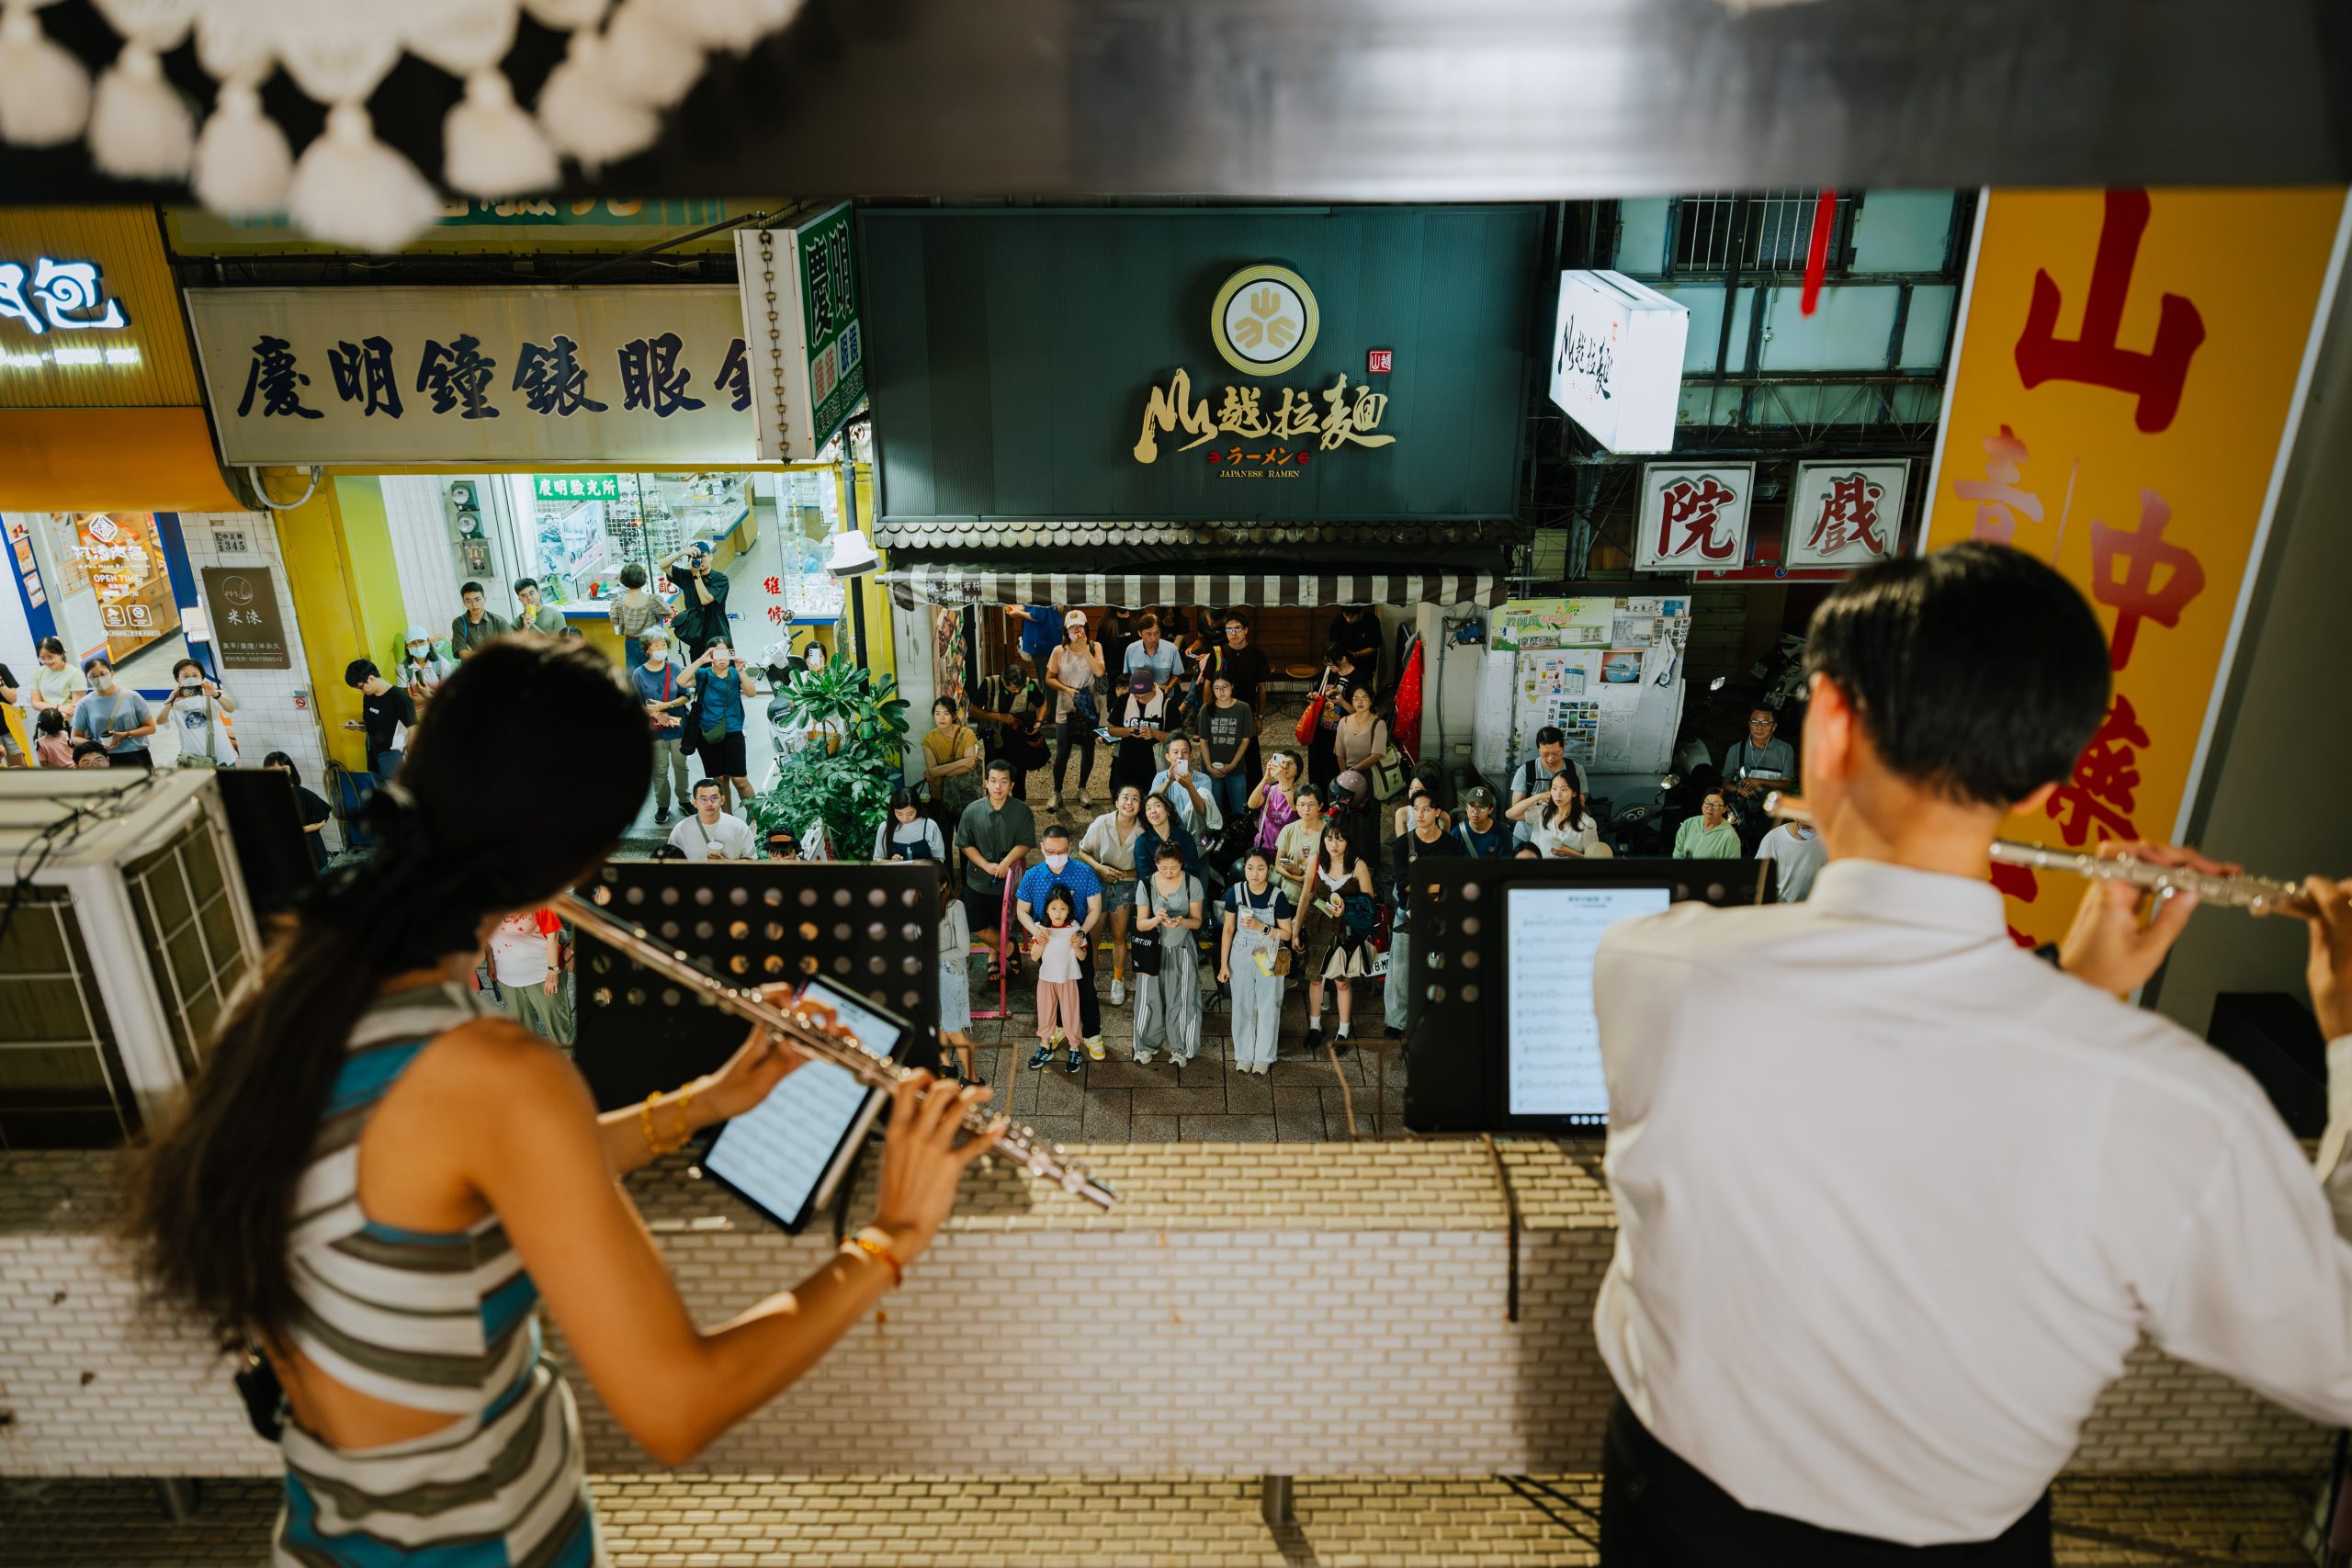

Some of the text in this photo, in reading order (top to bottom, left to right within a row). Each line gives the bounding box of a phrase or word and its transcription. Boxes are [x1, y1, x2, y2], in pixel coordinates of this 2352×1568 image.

[804, 218, 855, 350] 慶明
[2014, 186, 2207, 434] 山
[1133, 367, 1396, 464] 山越拉麵
[1227, 446, 1294, 466] ラーメン
[538, 479, 617, 497] 慶明驗光所
[1219, 469, 1300, 479] JAPANESE RAMEN
[1657, 478, 1736, 558] 院
[225, 541, 245, 551] 345
[93, 574, 118, 583] OPEN
[763, 575, 785, 626] 維修
